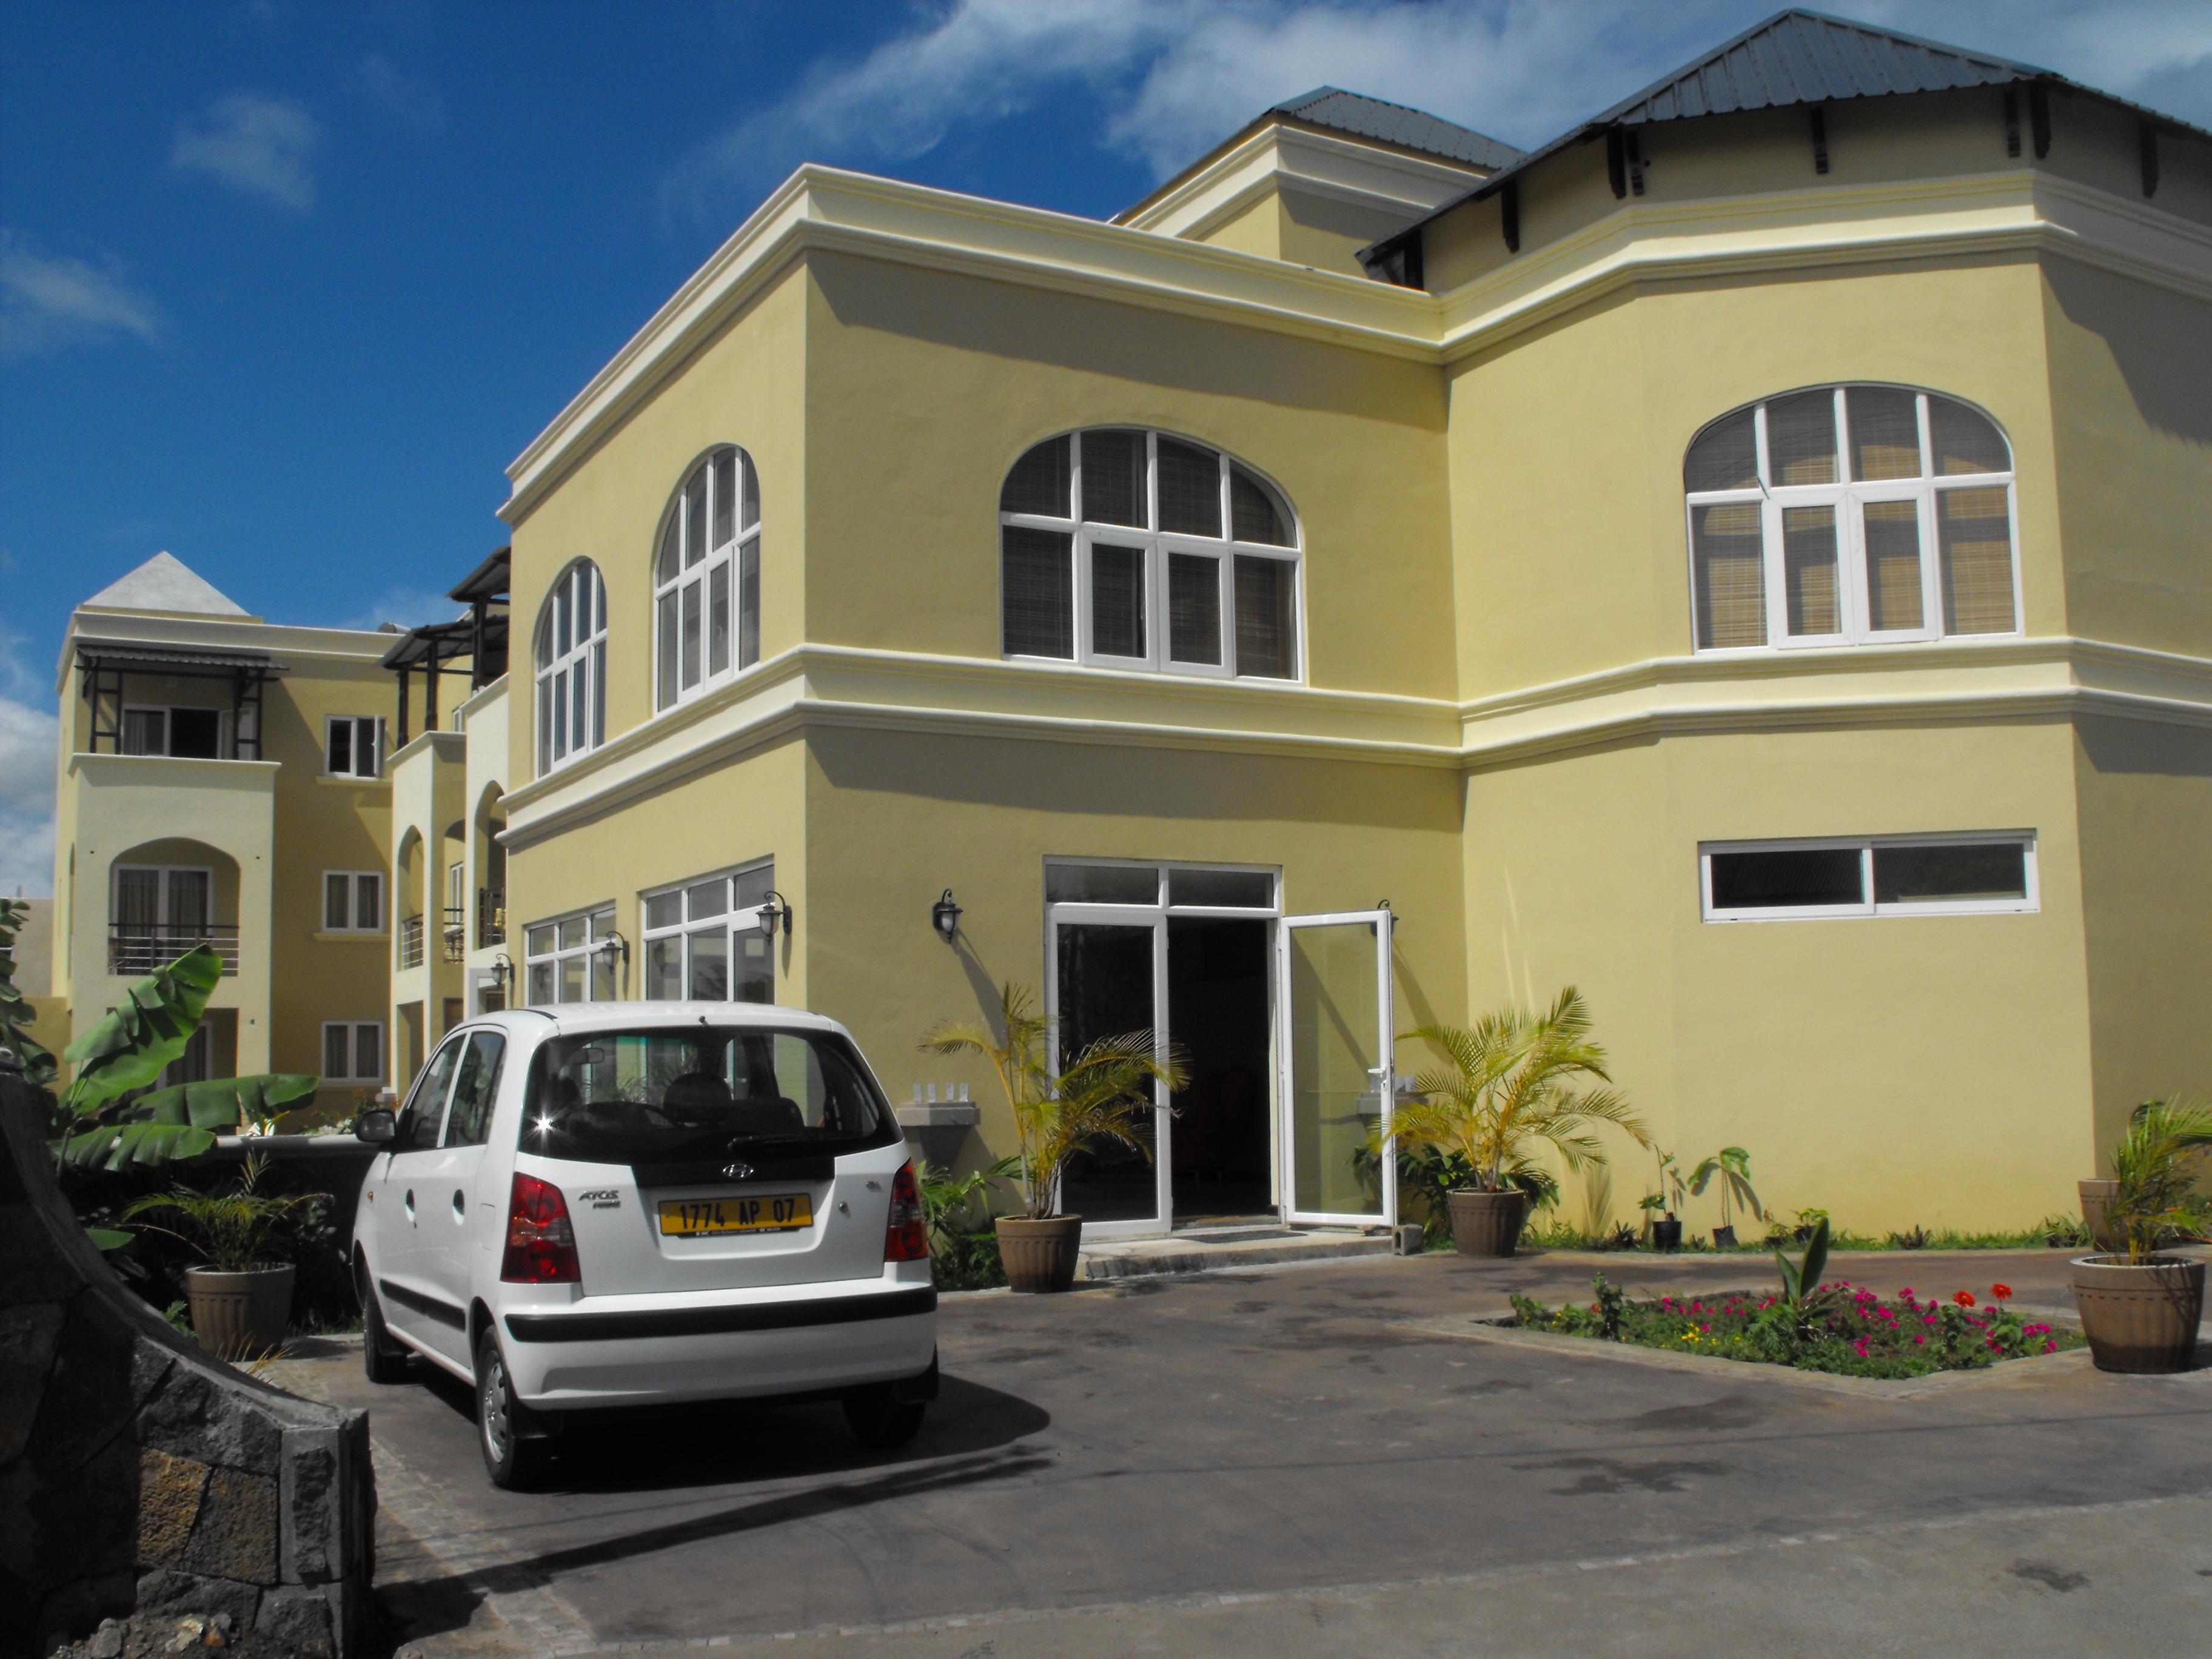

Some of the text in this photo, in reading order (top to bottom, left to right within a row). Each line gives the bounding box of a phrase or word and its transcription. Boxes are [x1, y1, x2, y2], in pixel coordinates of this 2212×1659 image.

[680, 1199, 795, 1229] 1774 AP 07
